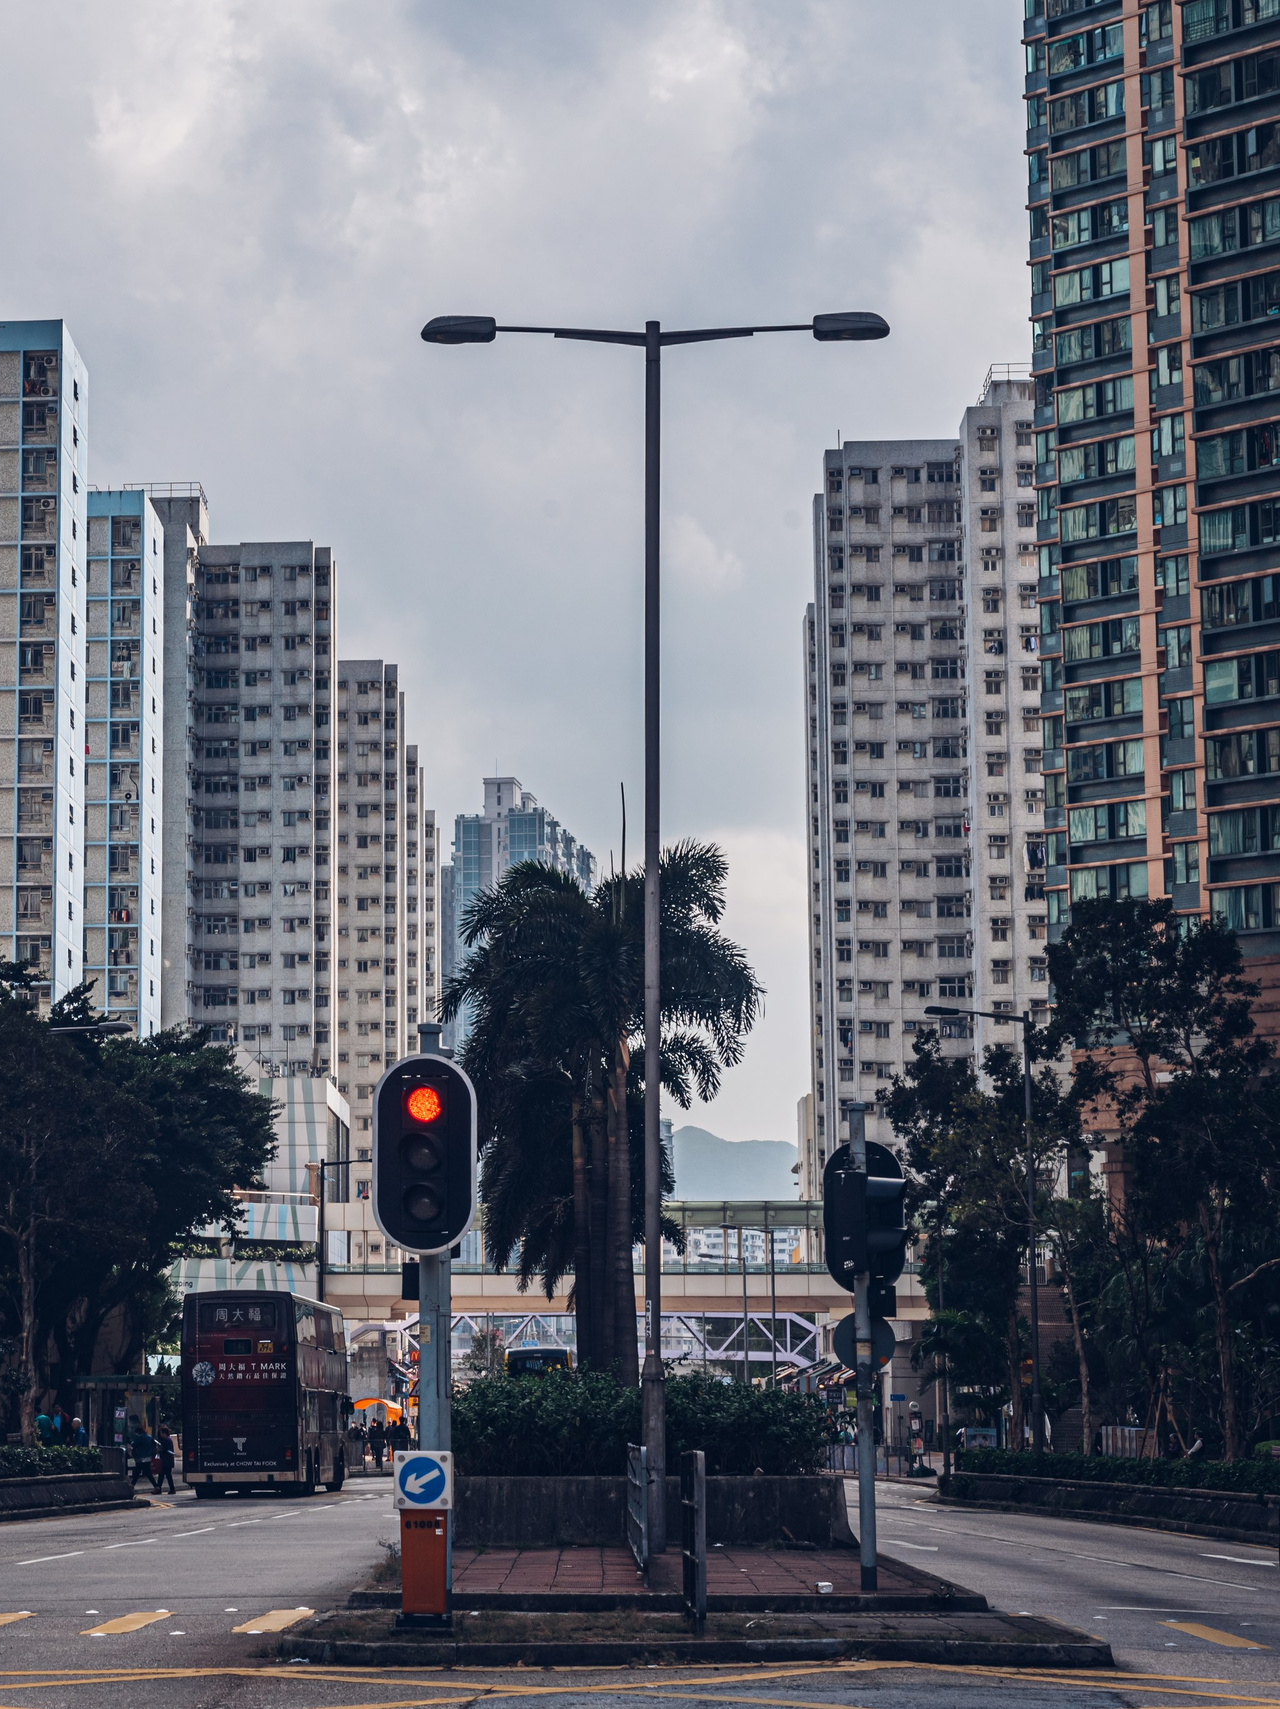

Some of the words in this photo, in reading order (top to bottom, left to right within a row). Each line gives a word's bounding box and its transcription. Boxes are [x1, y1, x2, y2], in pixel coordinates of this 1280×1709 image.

[215, 1307, 261, 1322] 周大福
[218, 1362, 246, 1371] 周大福
[251, 1362, 257, 1370] T
[260, 1362, 287, 1370] MARK
